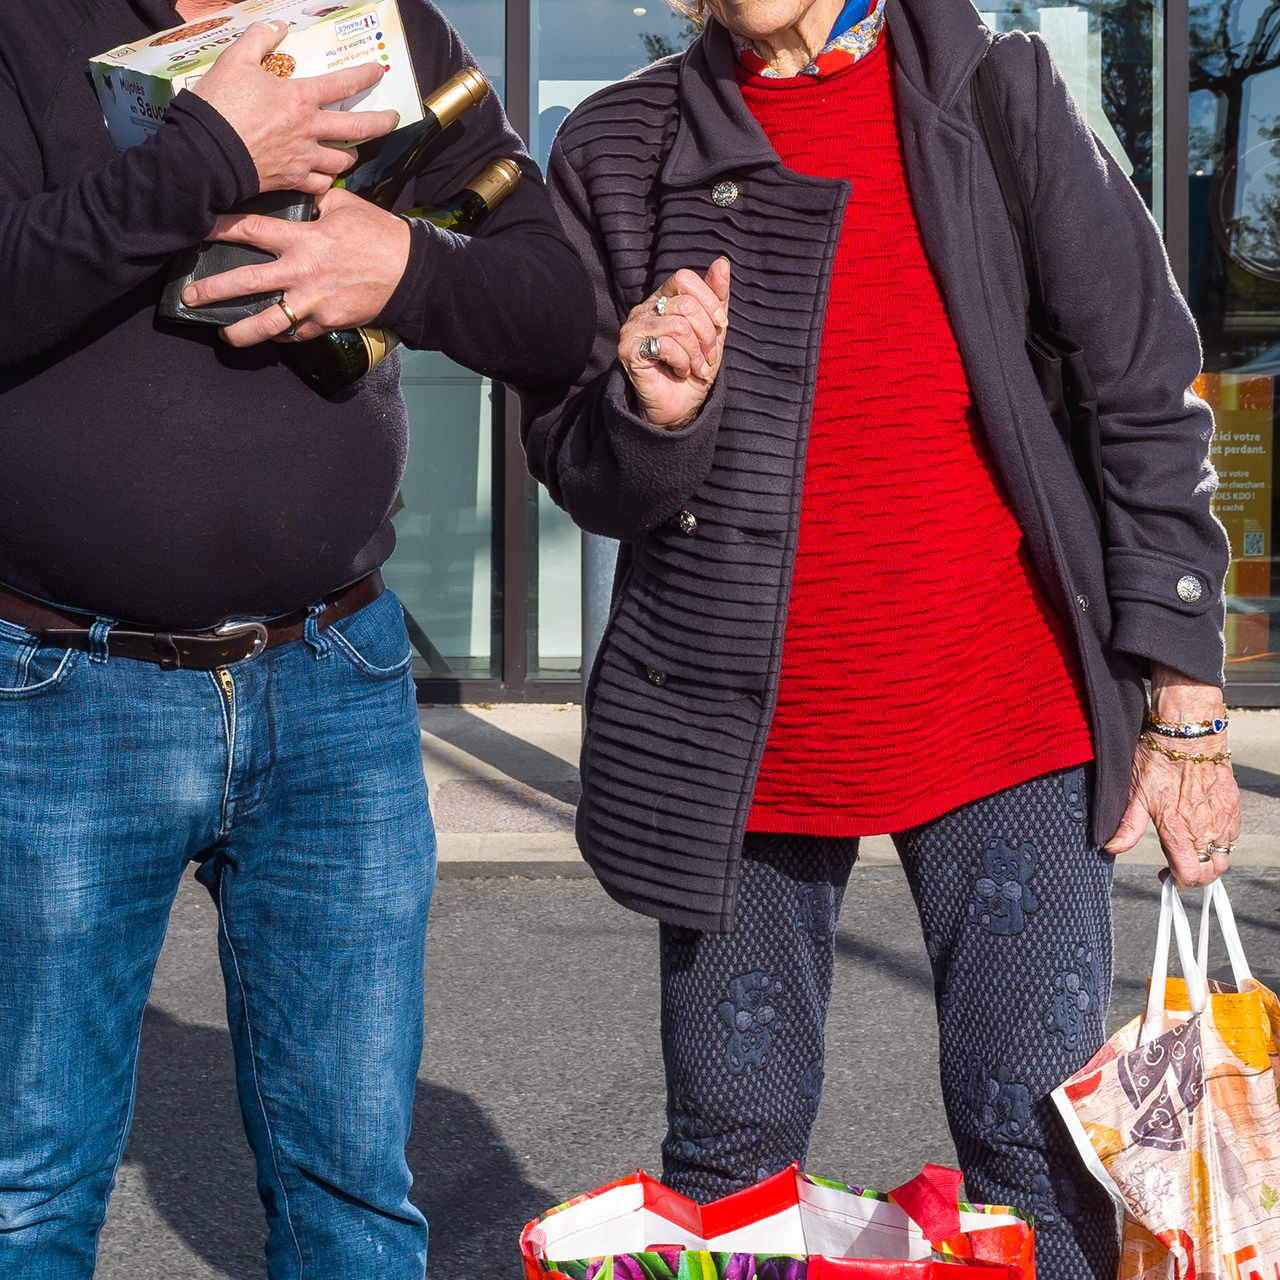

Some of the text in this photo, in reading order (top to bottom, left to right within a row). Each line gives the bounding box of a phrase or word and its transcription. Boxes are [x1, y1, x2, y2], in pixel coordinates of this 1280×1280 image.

[325, 49, 337, 57] Thon
[118, 76, 146, 97] Mijotés
[136, 96, 166, 121] Sauc
[1219, 431, 1231, 442] ici
[1233, 433, 1261, 442] votre
[1224, 445, 1267, 456] perdant.
[1229, 470, 1250, 478] votre
[1228, 481, 1265, 489] cherchant
[1233, 492, 1251, 500] KDO
[1222, 503, 1245, 512] caché
